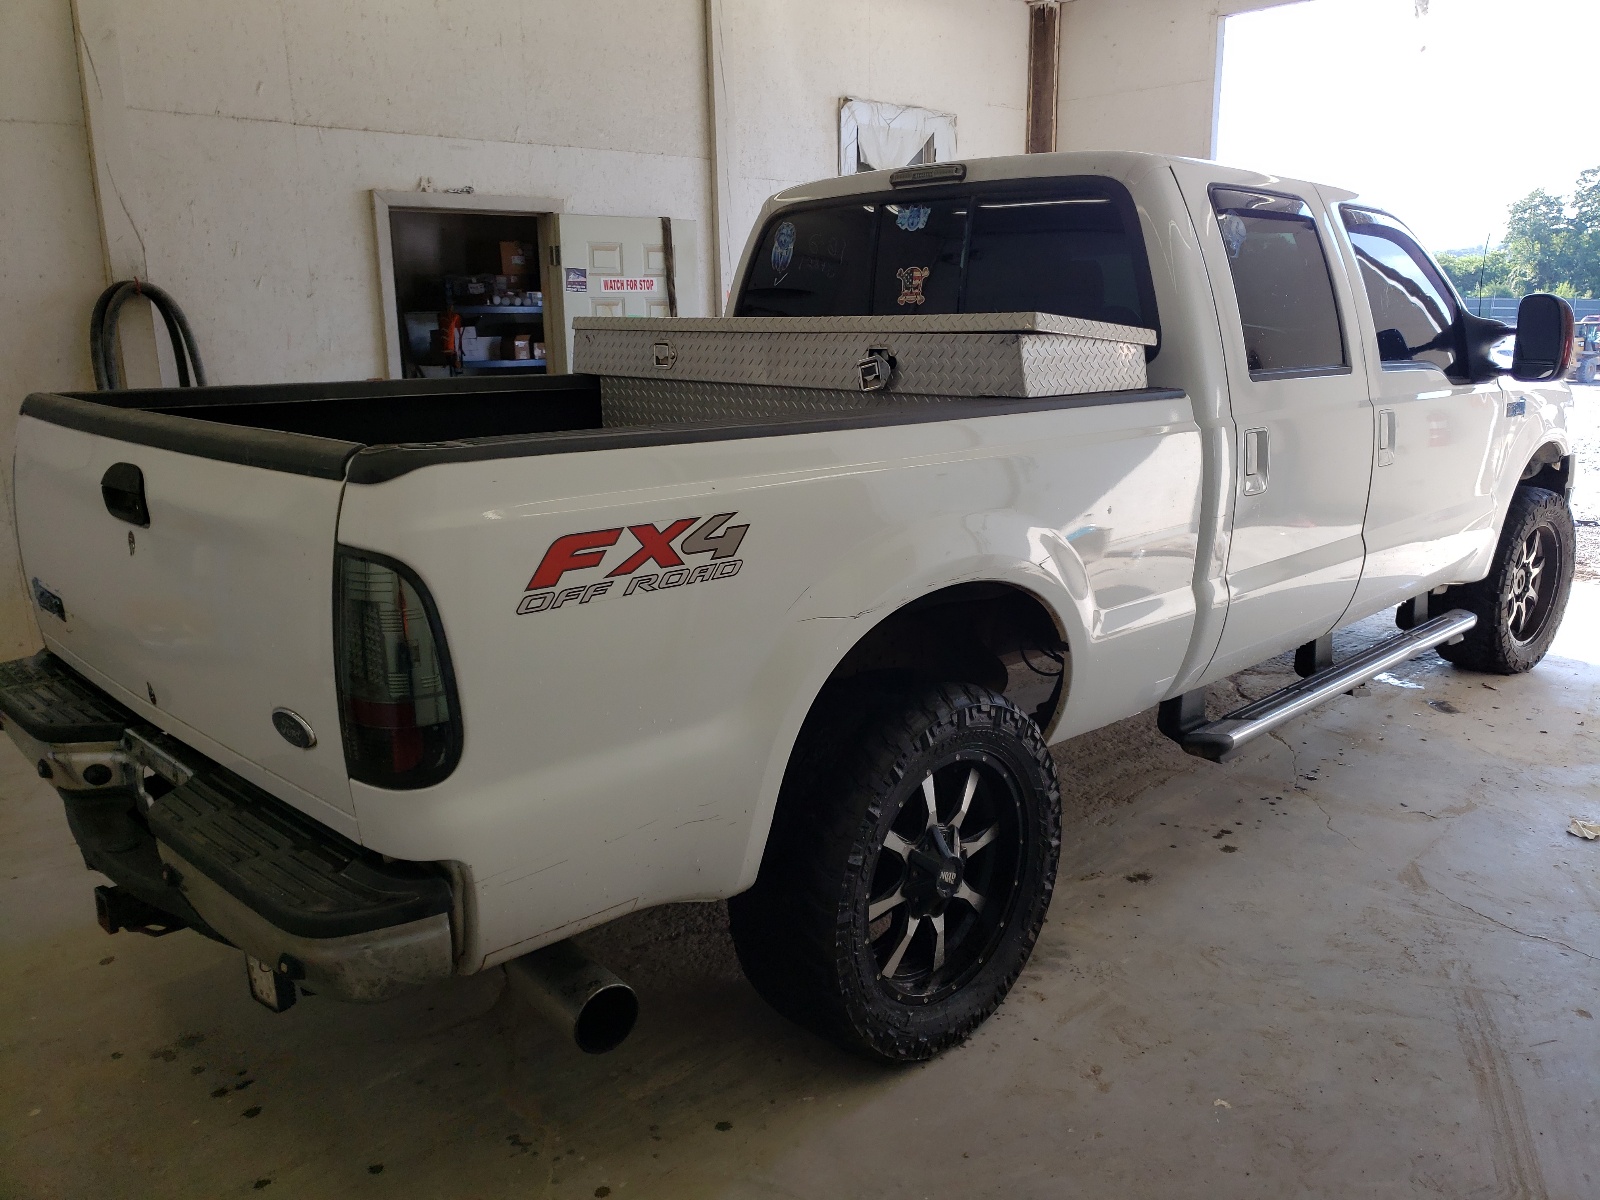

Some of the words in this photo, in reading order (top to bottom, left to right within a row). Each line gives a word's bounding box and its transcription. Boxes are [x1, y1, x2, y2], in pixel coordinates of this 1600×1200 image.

[603, 279, 625, 291] WATCH
[626, 279, 638, 291] FOR
[639, 279, 654, 291] STOP
[524, 511, 750, 592] FX4
[516, 581, 614, 615] OFF
[623, 559, 744, 597] ROAD
